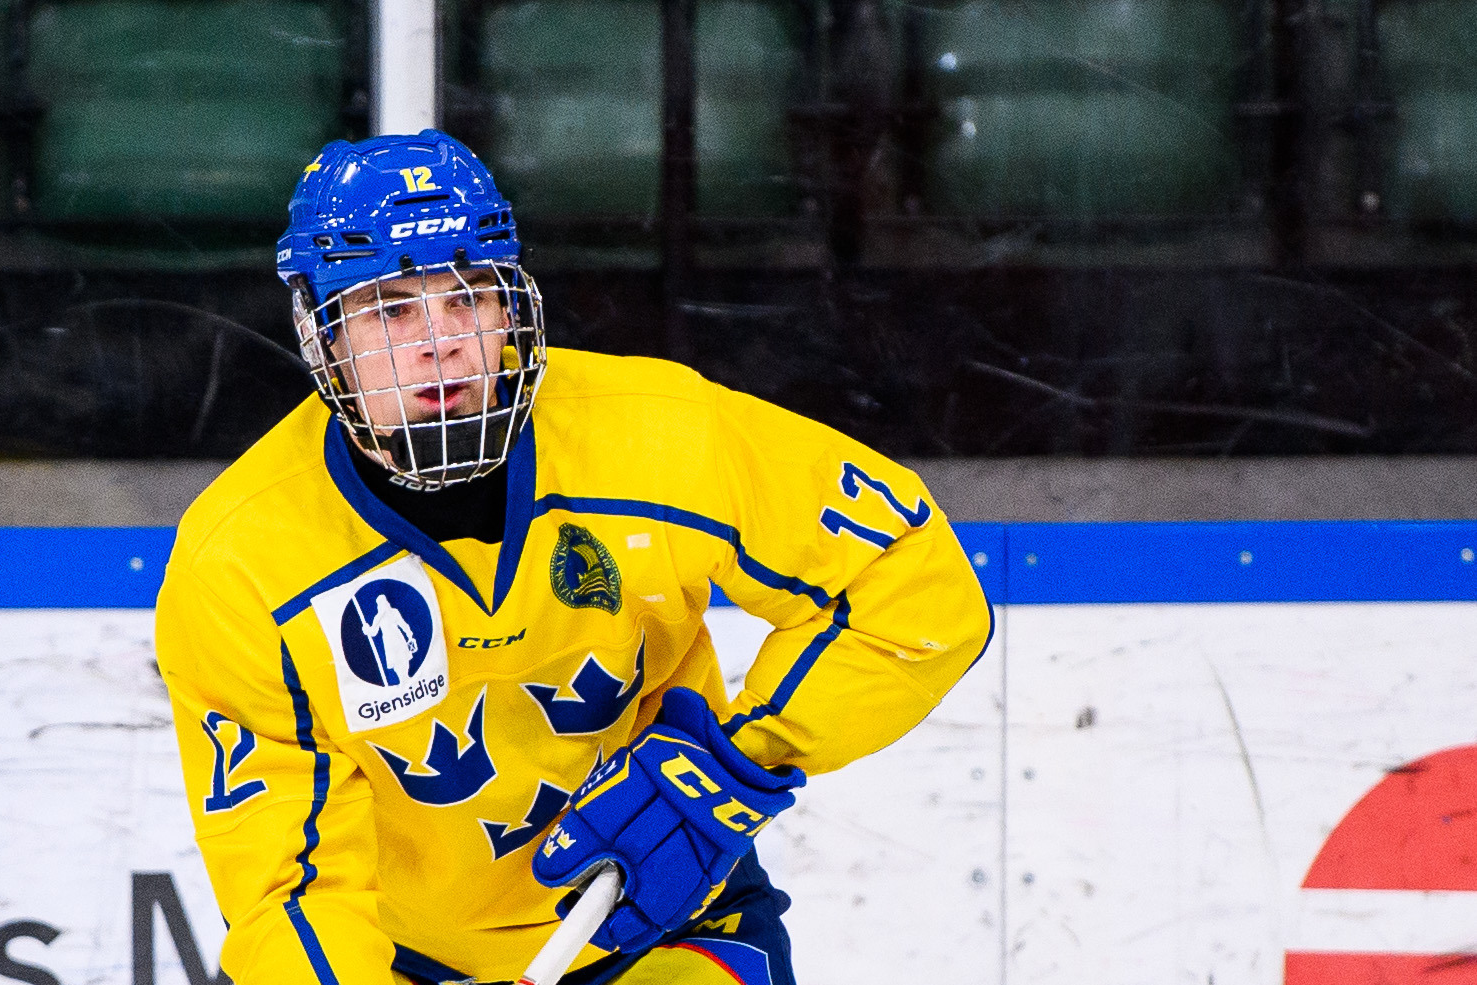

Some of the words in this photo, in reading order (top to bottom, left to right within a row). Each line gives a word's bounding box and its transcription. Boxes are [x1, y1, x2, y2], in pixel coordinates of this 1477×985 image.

[400, 166, 436, 192] 12
[389, 215, 468, 239] CCM
[819, 461, 932, 553] 12
[457, 627, 528, 650] CCM
[358, 672, 445, 721] Gjensidige
[200, 710, 268, 814] 12
